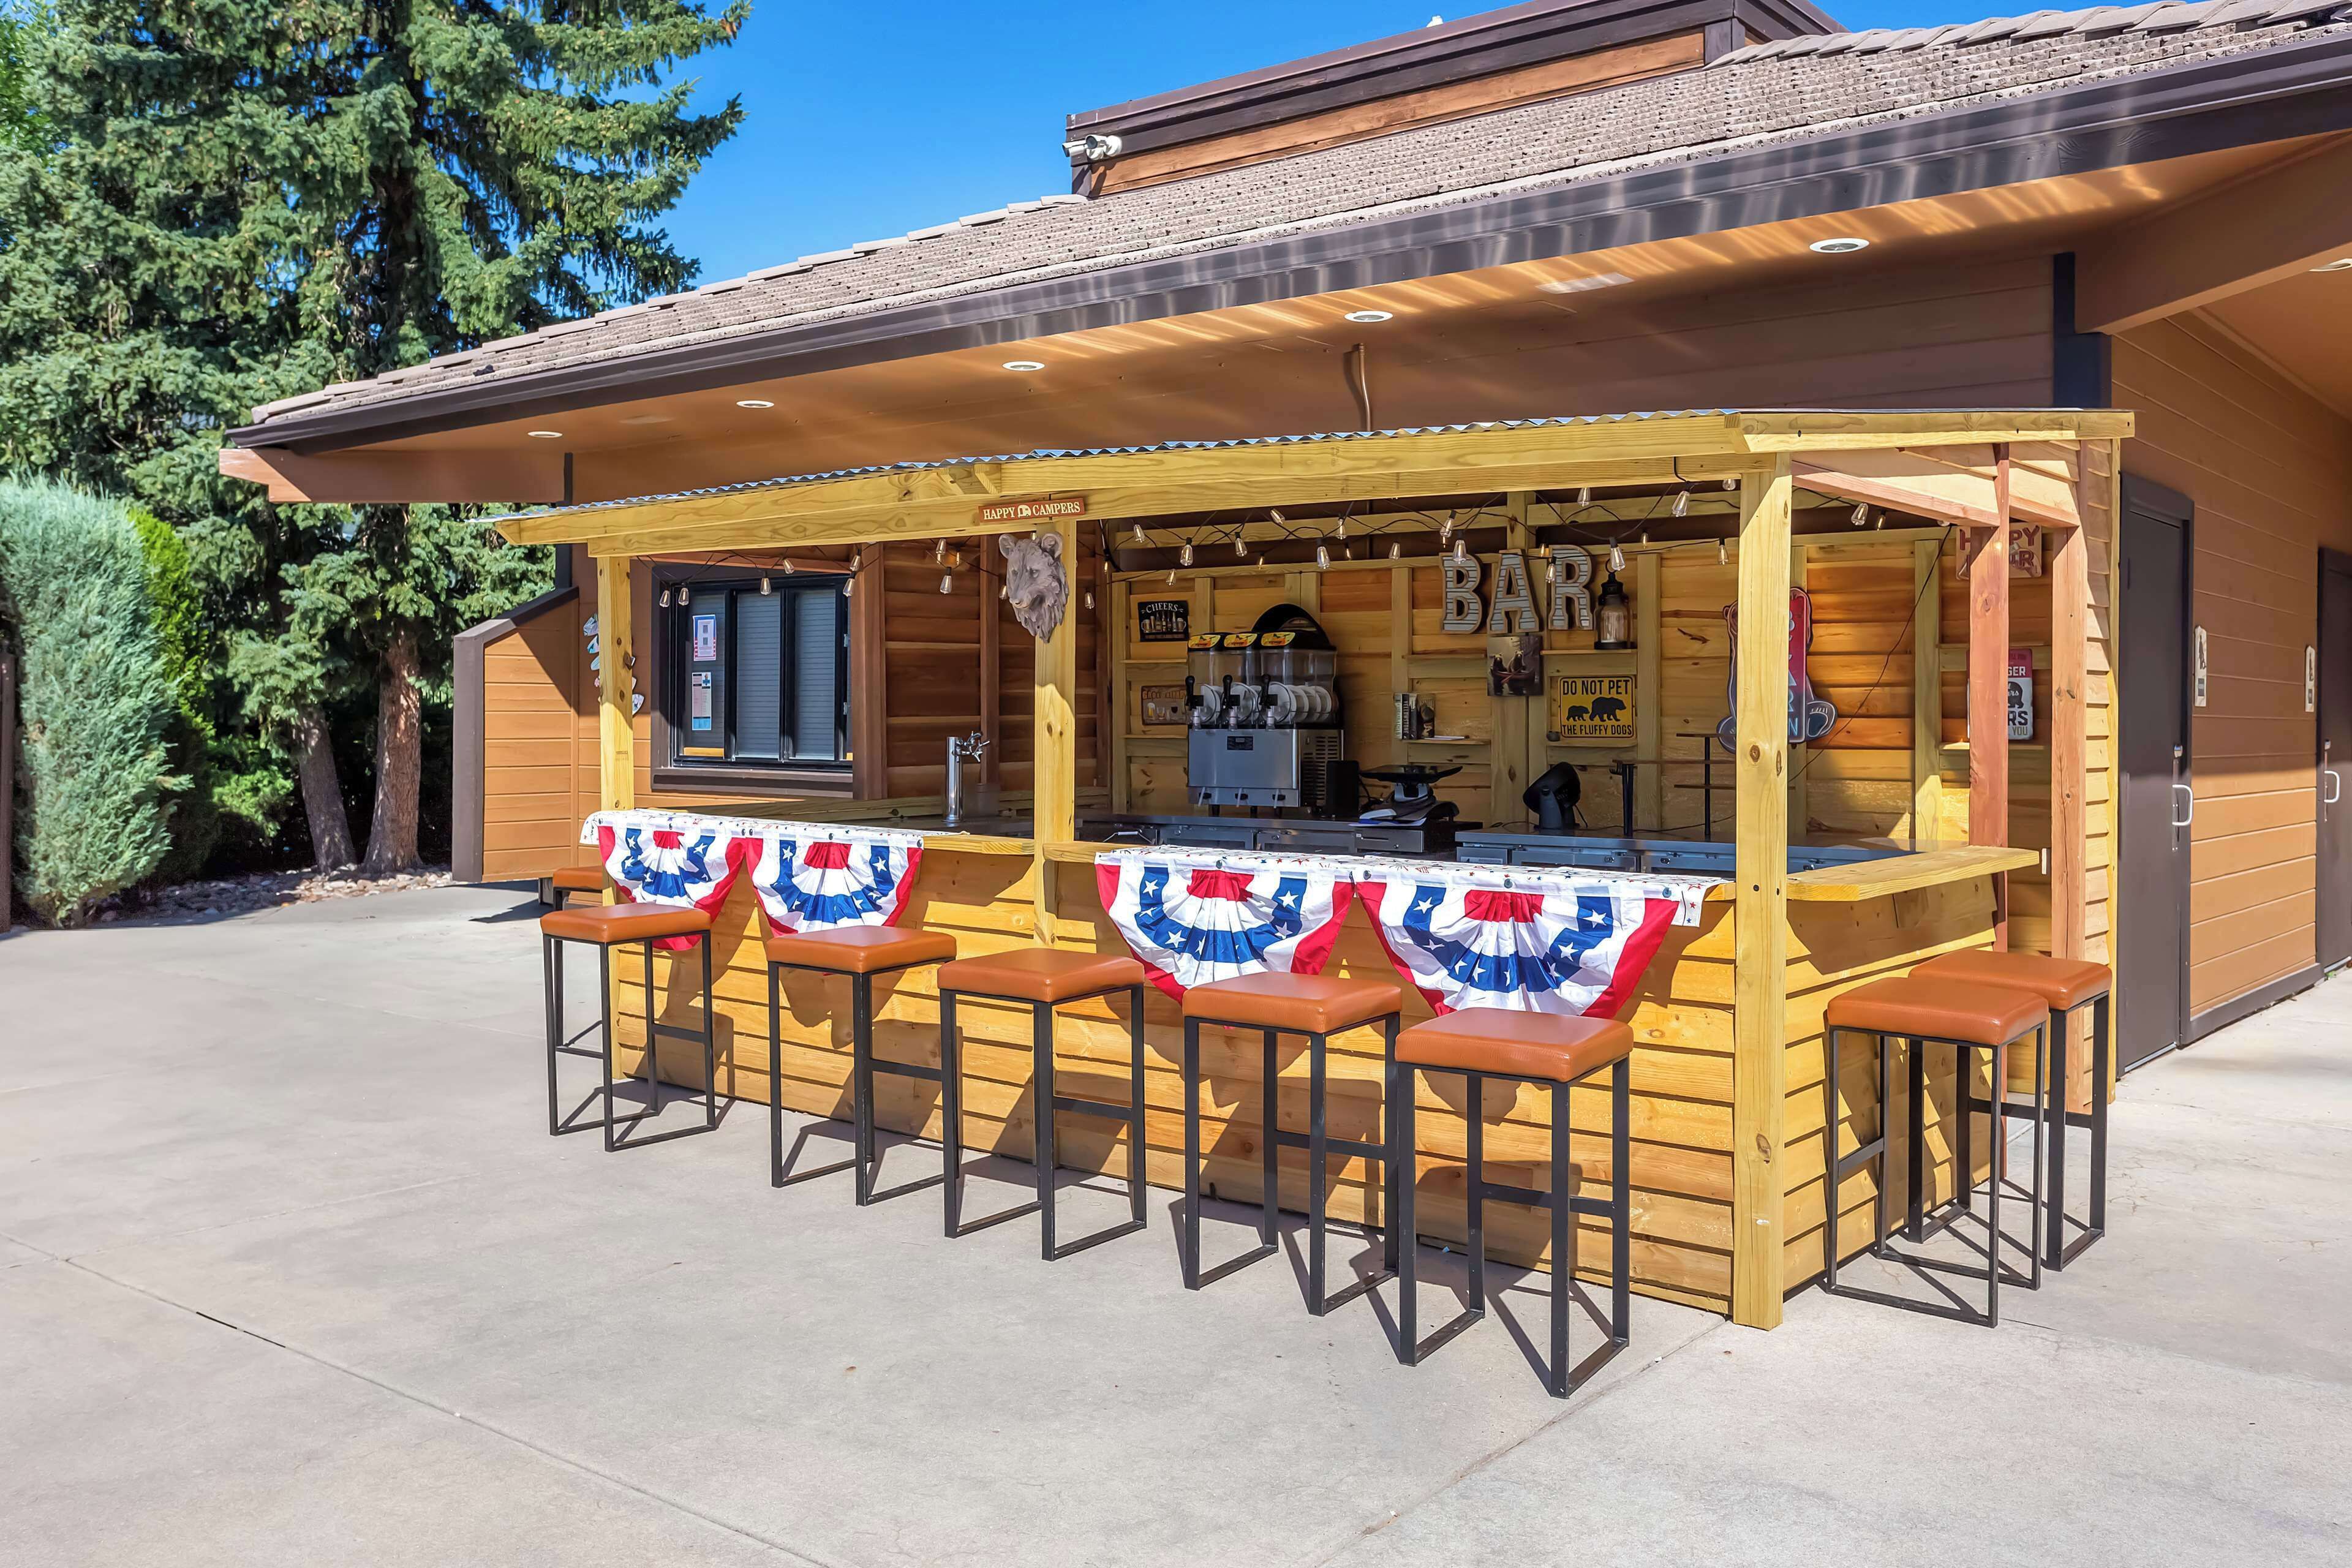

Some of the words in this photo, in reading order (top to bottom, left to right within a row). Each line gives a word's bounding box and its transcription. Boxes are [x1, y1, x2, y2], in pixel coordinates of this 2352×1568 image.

[983, 507, 1016, 520] HAPPY
[1032, 501, 1081, 516] CAMPERS
[1959, 525, 2040, 551] HPY
[1439, 544, 1593, 635] BAR
[1146, 602, 1179, 613] CHEERS
[1562, 680, 1577, 695] DO
[1581, 680, 1604, 695] NOT
[1608, 679, 1630, 695] PET
[1562, 725, 1577, 735] THE
[1580, 725, 1608, 735] FLUFFY
[1611, 725, 1632, 735] DOGS
[2012, 726, 2028, 736] YOU
